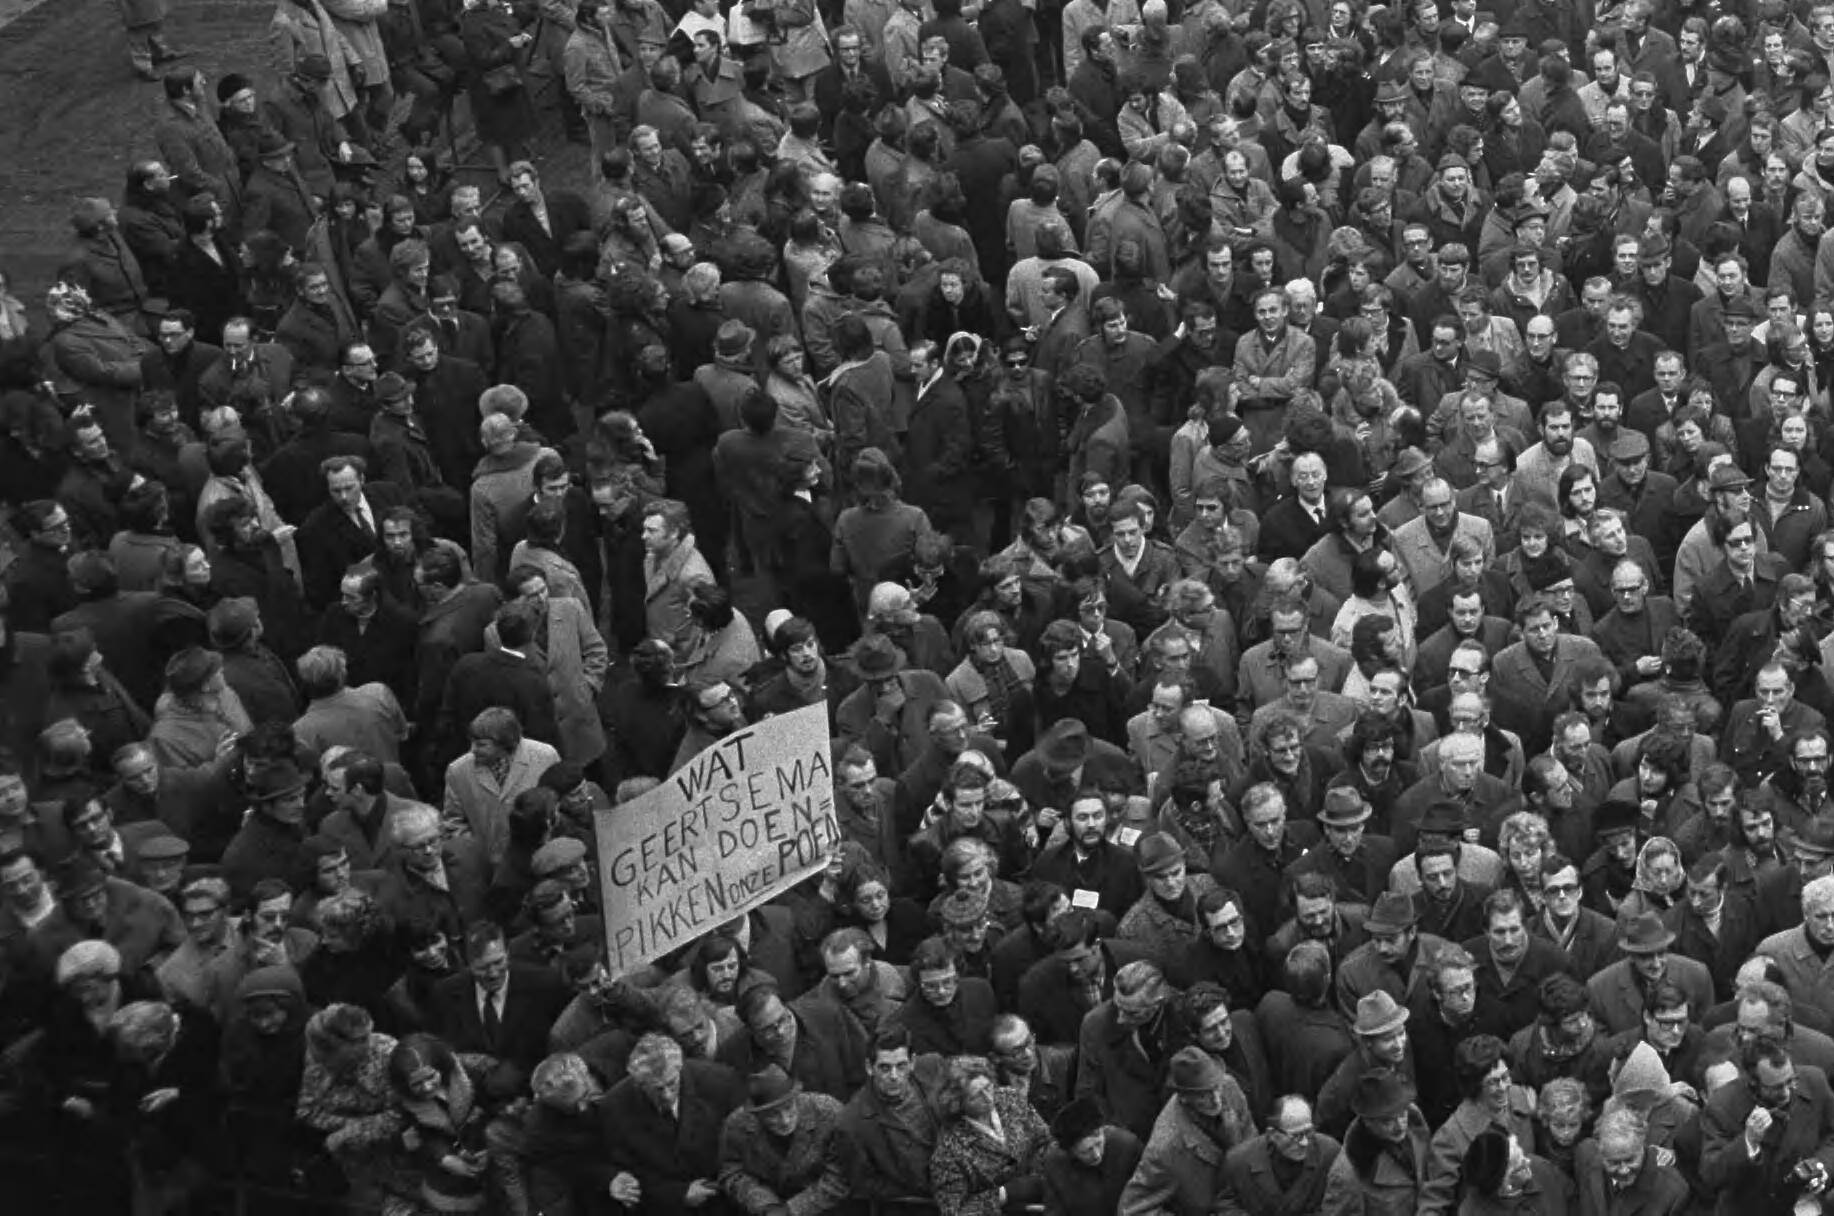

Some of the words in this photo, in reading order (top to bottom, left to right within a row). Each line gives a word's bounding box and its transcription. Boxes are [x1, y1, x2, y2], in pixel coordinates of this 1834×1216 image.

[677, 732, 755, 802] WAT
[611, 751, 829, 886] GEERTSEMA
[614, 873, 728, 969] PIKKEN
[728, 864, 775, 905] ONZE
[777, 813, 842, 877] POEN
[637, 846, 698, 906] KAN
